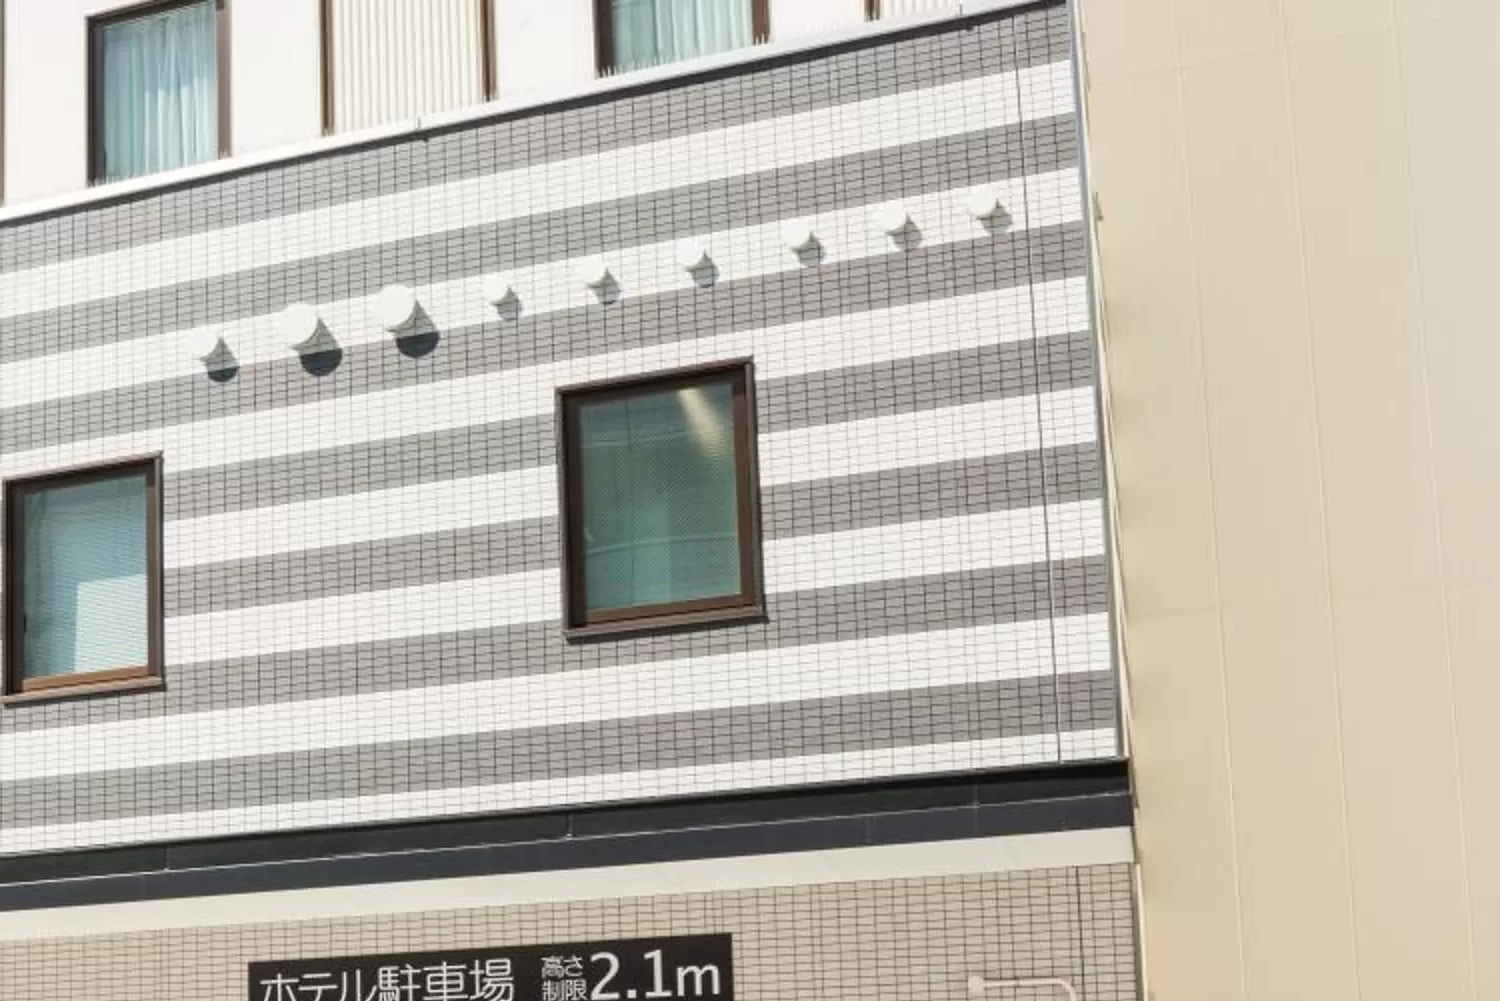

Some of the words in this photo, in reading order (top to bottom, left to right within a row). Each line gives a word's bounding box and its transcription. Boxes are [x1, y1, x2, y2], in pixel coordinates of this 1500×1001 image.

[541, 955, 583, 978] 高さ
[590, 949, 720, 1001] 2.1m
[542, 979, 588, 1001] 制限
